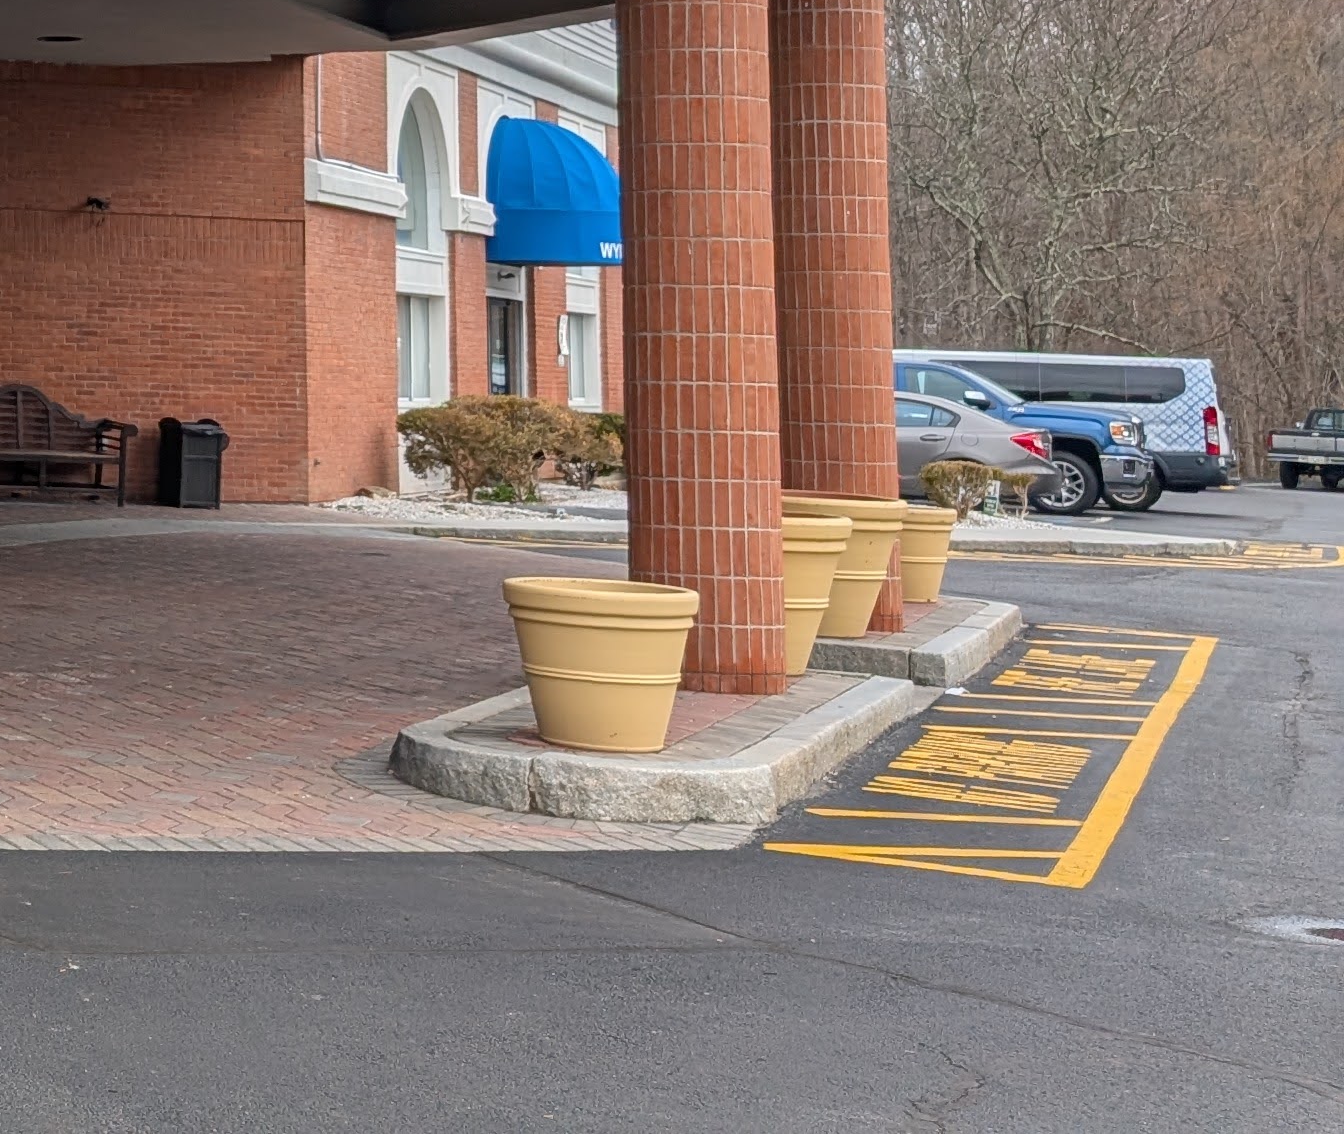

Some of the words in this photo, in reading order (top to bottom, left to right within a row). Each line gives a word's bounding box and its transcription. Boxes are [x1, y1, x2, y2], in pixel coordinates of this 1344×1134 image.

[1014, 649, 1156, 680] LANE
[990, 669, 1141, 698] FIRE
[887, 730, 1093, 790] PARKING
[861, 775, 1061, 813] NO
